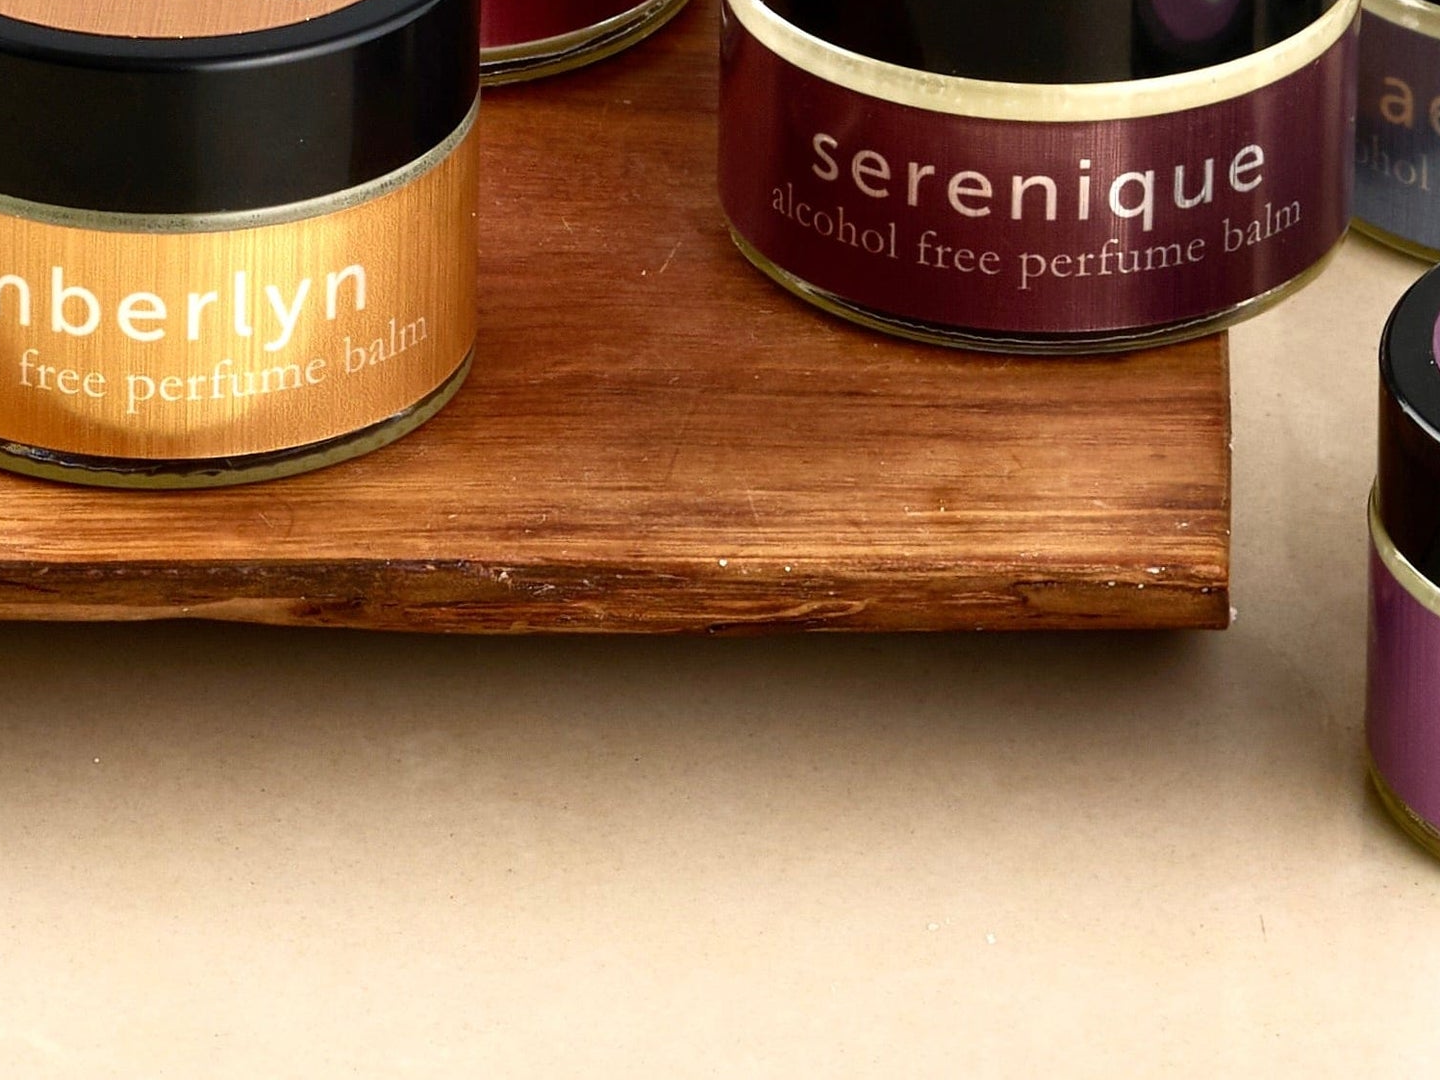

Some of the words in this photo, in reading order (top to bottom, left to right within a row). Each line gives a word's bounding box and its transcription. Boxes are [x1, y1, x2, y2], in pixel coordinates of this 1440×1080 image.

[811, 131, 1263, 231] serenique
[772, 182, 898, 259] alcohol
[917, 231, 1001, 275] free
[1018, 234, 1206, 290] perfume
[1223, 200, 1303, 254] balm
[19, 349, 108, 399] free
[126, 354, 328, 414] perfume
[343, 314, 428, 375] balm
